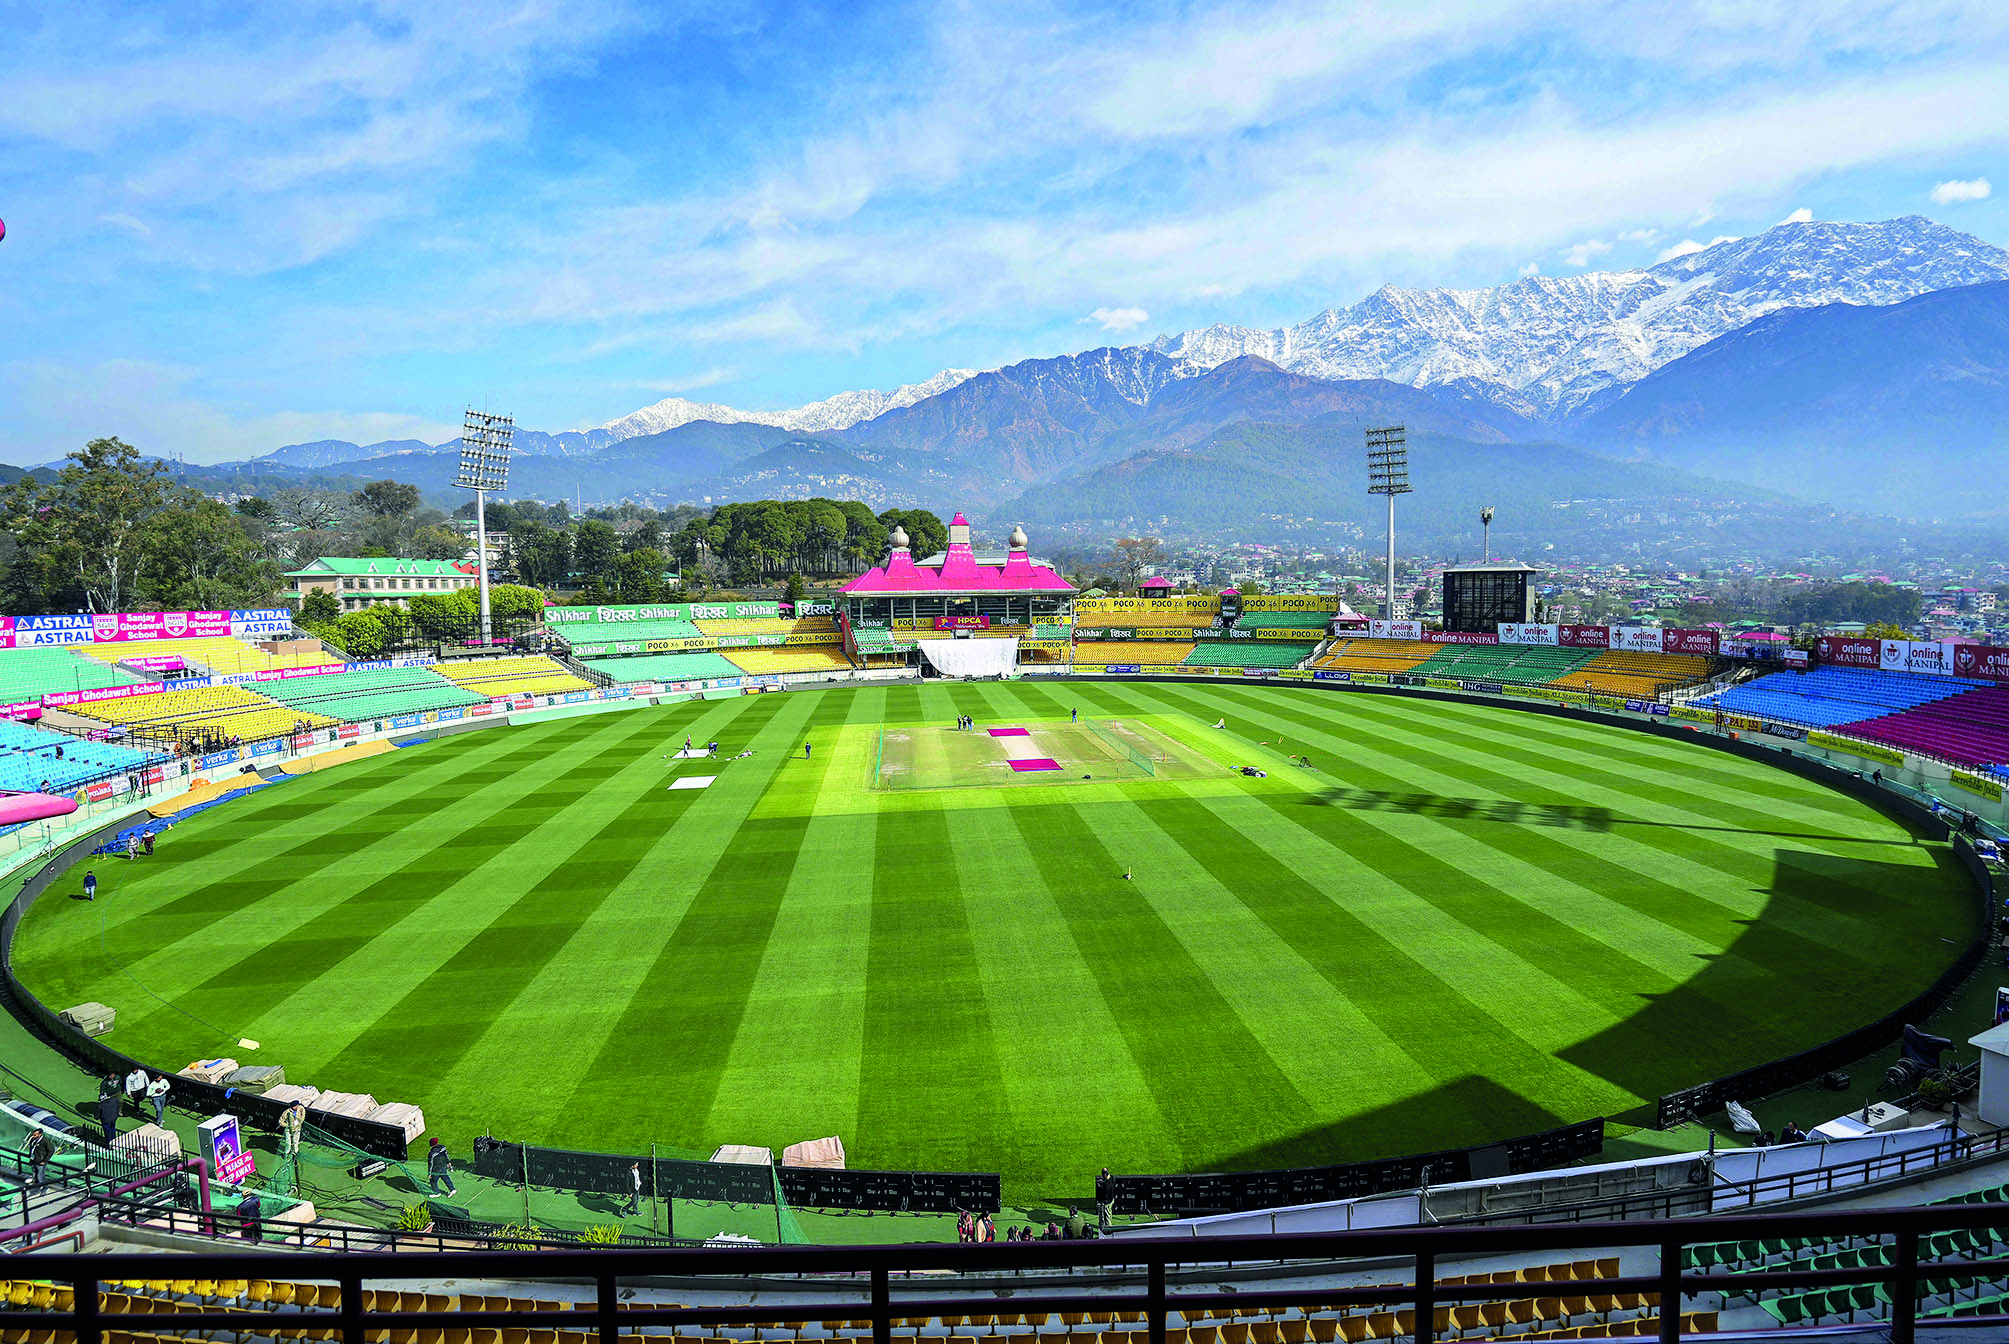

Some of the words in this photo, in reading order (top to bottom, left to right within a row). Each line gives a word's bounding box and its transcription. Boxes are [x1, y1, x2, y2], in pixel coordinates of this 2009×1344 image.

[1076, 600, 1097, 608] POCO
[1320, 596, 1338, 604] POCO
[597, 605, 638, 622] शिखर
[640, 607, 681, 619] Shikhar
[689, 603, 728, 619] शिखर
[735, 604, 777, 616] Shikhar
[126, 613, 156, 623] Sanjay
[194, 611, 222, 621] Sanjay
[241, 610, 290, 621] ASTRAL
[545, 610, 592, 623] Shikhar
[32, 616, 92, 630] ASTRAL
[120, 621, 164, 631] Ghodawat
[188, 620, 230, 629] Ghodawat
[244, 622, 291, 633] ASTRAL
[857, 619, 885, 627] Shikhar
[1391, 622, 1414, 631] online
[127, 631, 158, 639] School
[195, 628, 224, 636] School
[1074, 629, 1105, 637] Shikhar
[1193, 629, 1223, 637] Shikhar
[1524, 626, 1548, 636] online
[1580, 629, 1603, 638] online
[1632, 631, 1657, 641] online
[34, 631, 93, 644] ASTRAL
[720, 637, 751, 647] Shikhar
[785, 635, 803, 643] POCO
[1431, 634, 1457, 643] online
[1458, 636, 1497, 645] MANIPAL
[1519, 635, 1554, 643] MANIPAL
[1575, 637, 1609, 645] MANIPAL
[1686, 634, 1712, 644] online
[647, 641, 668, 649] POCO
[1627, 639, 1663, 648] MANIPAL
[573, 645, 609, 656] Shikhar
[1841, 643, 1872, 655] online
[1911, 647, 1944, 660] online
[403, 658, 436, 668] ASTRAL
[1835, 653, 1879, 665] MANIPAL
[1987, 653, 2009, 666] onli
[356, 660, 392, 672] ASTRAL
[1904, 658, 1952, 671] MANIPAL
[256, 671, 282, 682] Sanjay
[284, 667, 320, 679] Ghodawat
[321, 663, 345, 674] School
[175, 678, 211, 691] ASTRAL
[222, 674, 256, 685] ASTRAL
[1463, 681, 1481, 691] IHG
[43, 692, 80, 706] Sanjay
[82, 686, 131, 701] Ghodawat
[132, 682, 163, 695] School
[1951, 772, 1983, 793] Incredible
[225, 1158, 244, 1174] PLEASE
[235, 1163, 252, 1180] AWAY
